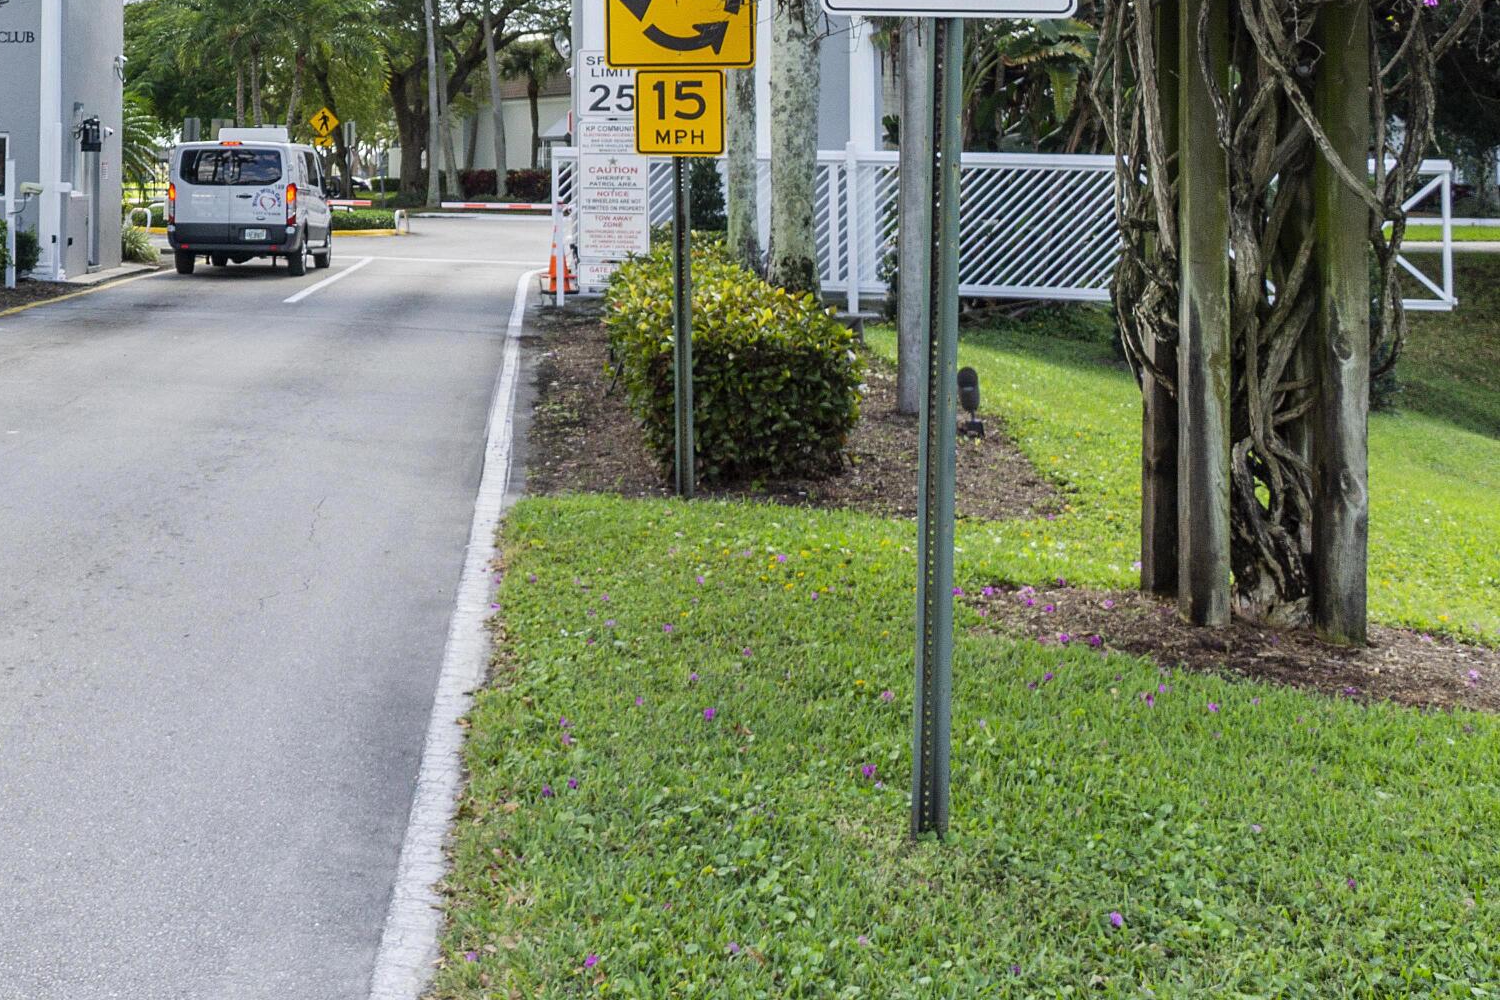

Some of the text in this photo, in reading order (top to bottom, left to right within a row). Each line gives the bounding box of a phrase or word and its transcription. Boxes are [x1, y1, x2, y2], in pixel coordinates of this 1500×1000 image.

[589, 84, 634, 111] 25
[653, 81, 706, 120] 15
[656, 130, 704, 145] MPH
[588, 166, 638, 174] CAUTION
